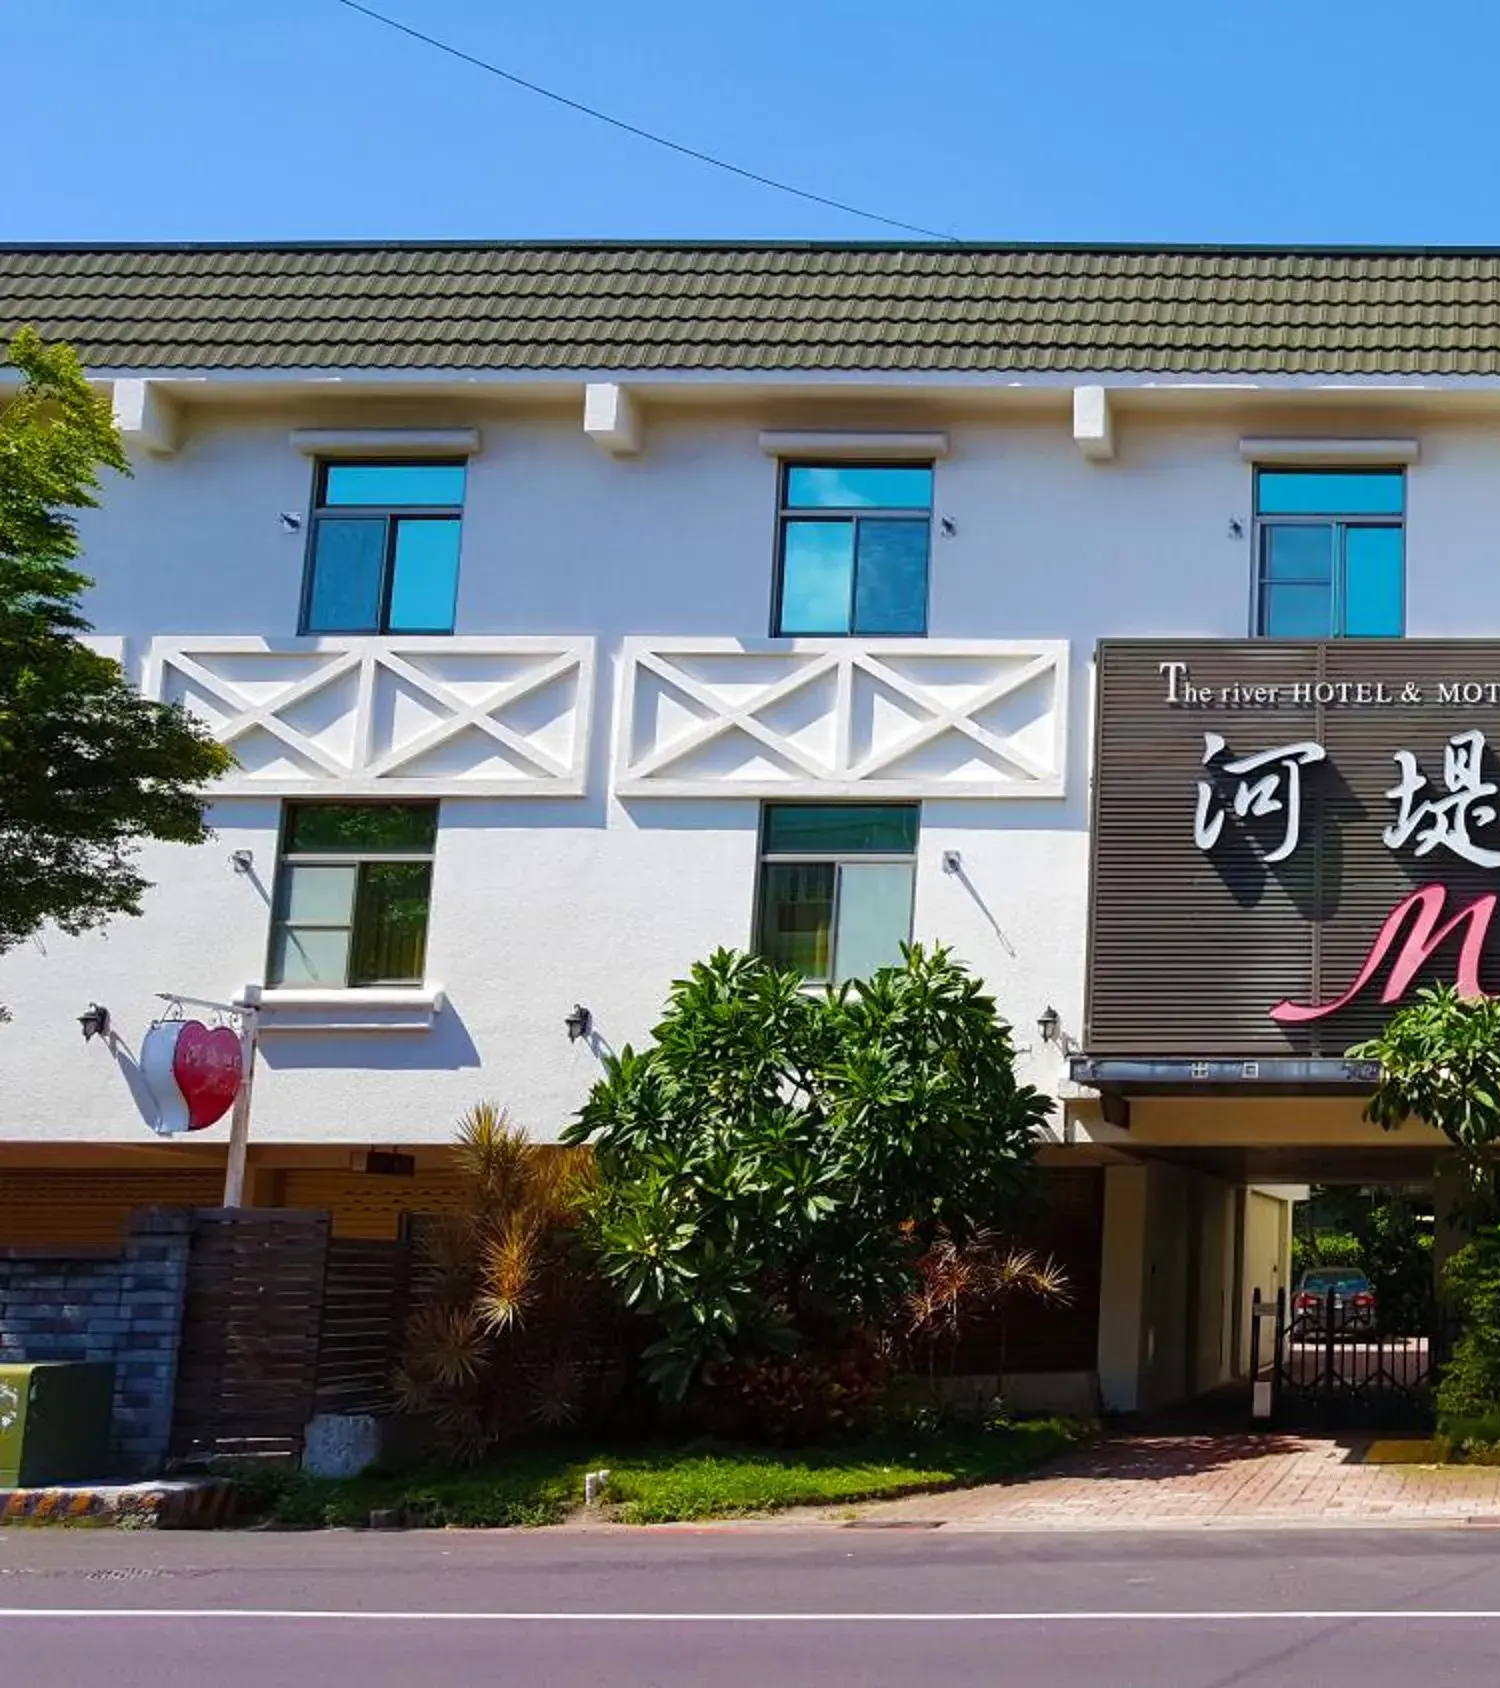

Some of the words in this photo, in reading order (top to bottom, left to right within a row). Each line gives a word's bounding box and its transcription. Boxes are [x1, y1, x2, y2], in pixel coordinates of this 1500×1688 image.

[1160, 661, 1211, 703] The
[1221, 682, 1280, 703] river
[1292, 682, 1393, 704] HOTEL
[1400, 682, 1422, 703] &
